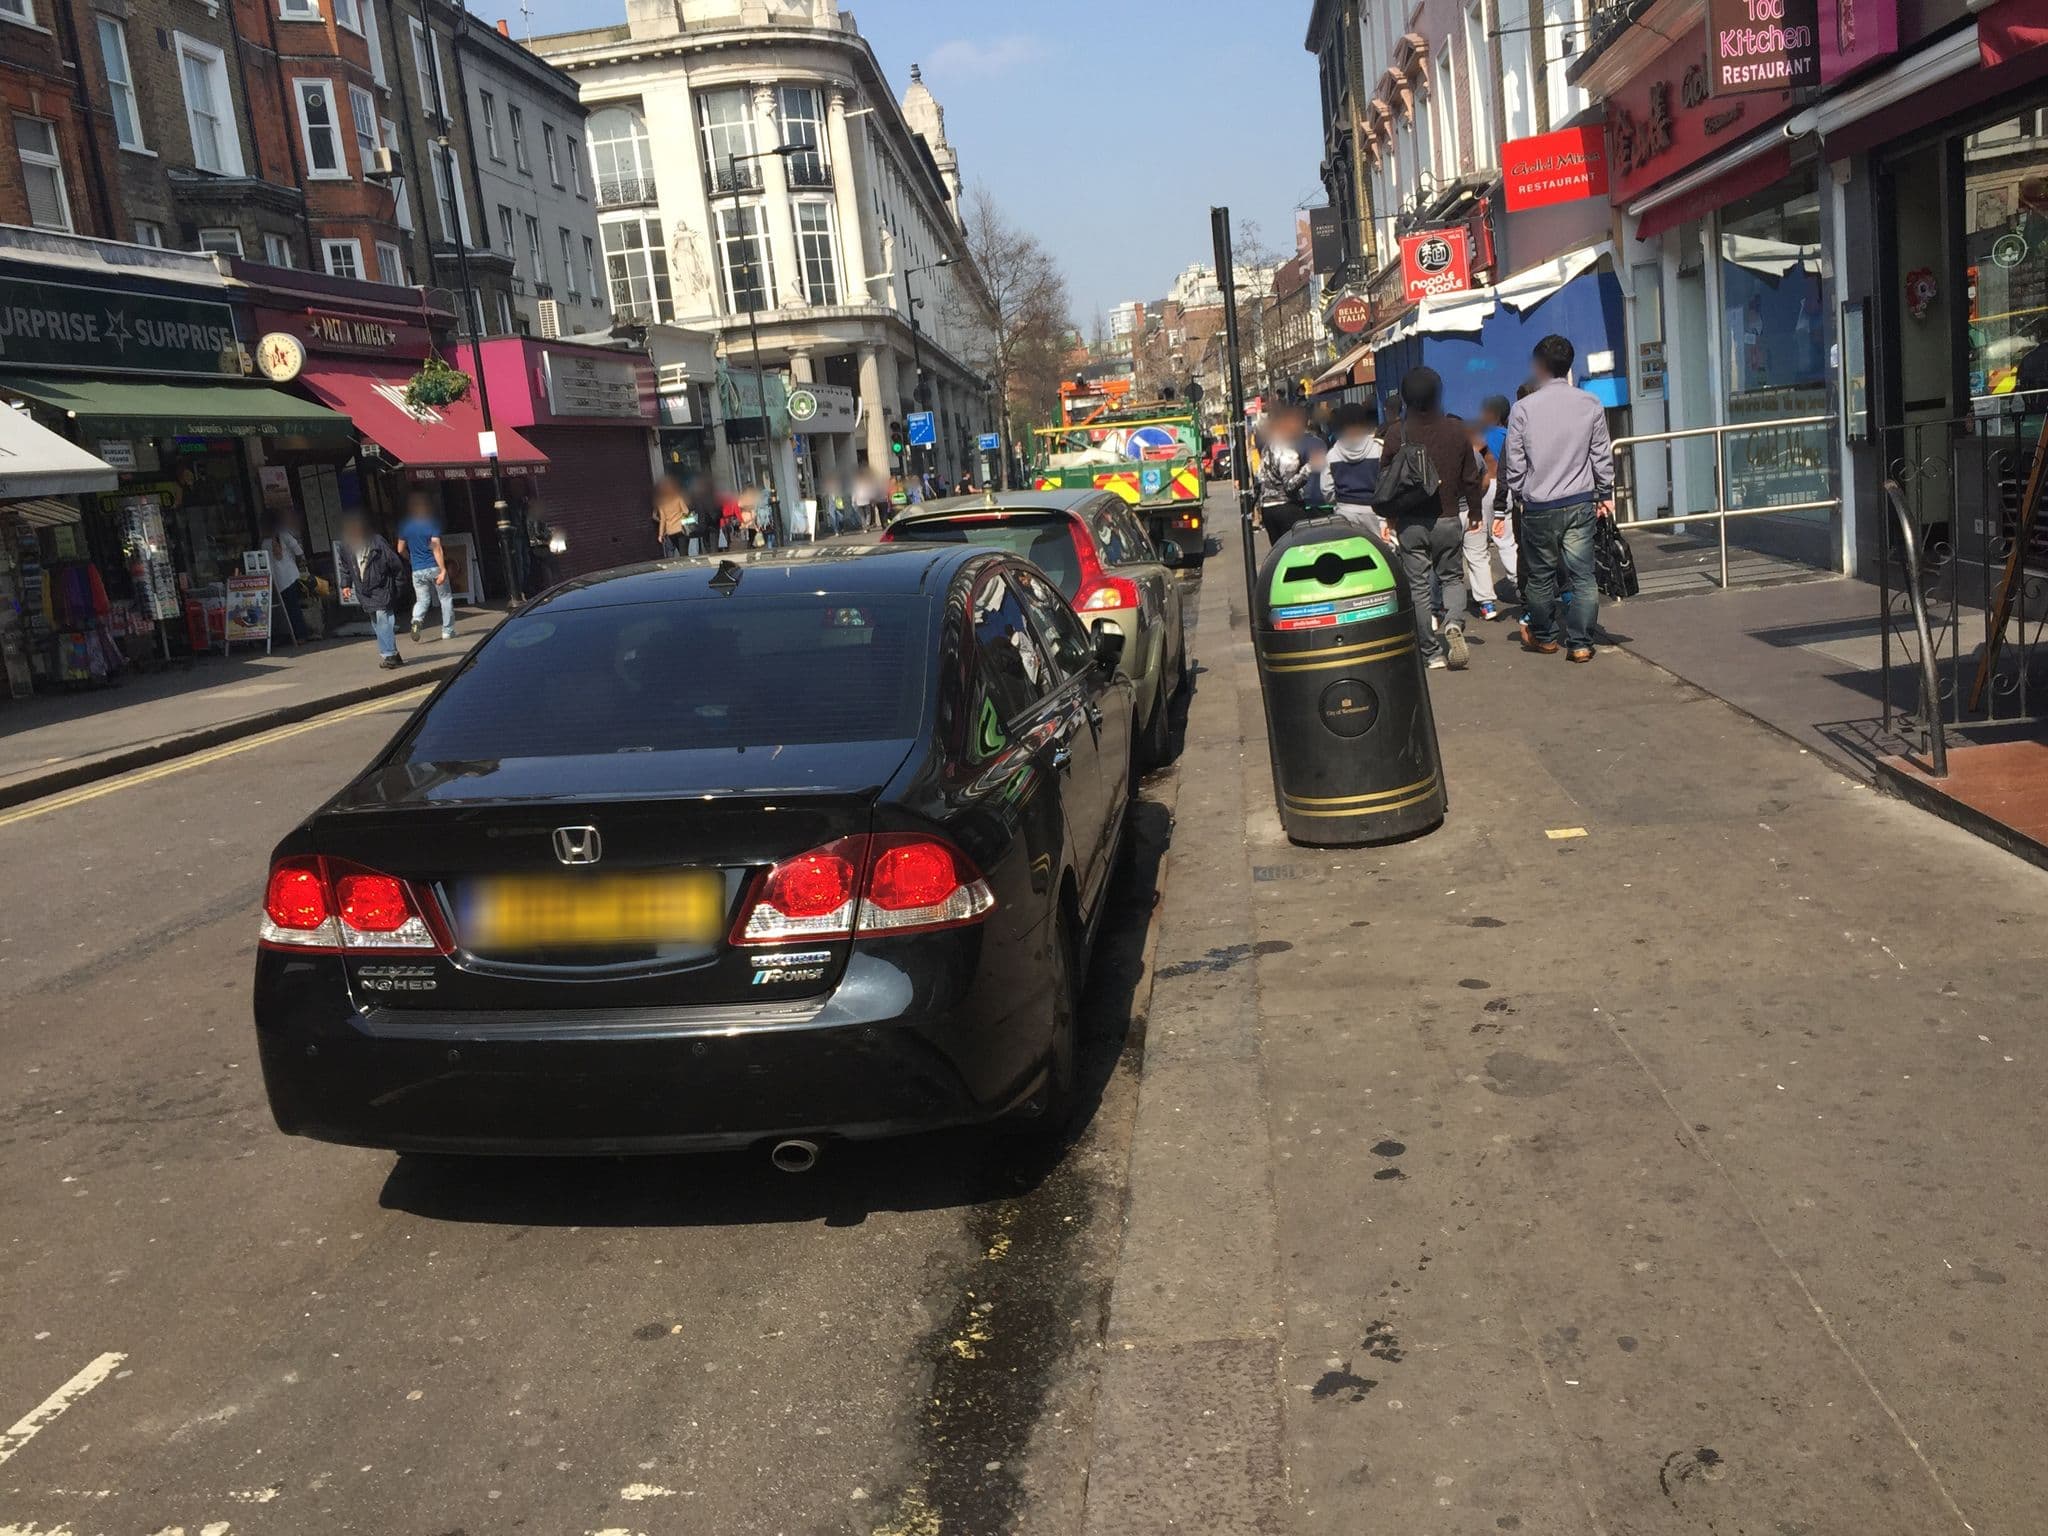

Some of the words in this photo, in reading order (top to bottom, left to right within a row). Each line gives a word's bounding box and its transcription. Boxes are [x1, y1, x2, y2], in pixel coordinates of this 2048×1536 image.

[1720, 24, 1811, 58] Kitchen
[1722, 57, 1812, 85] RESTAURANT
[1511, 157, 1553, 176] Gold
[1556, 151, 1600, 169] Mine
[1518, 172, 1595, 194] RESTAURANT
[1338, 306, 1366, 317] BELLA
[1338, 314, 1367, 324] ITALIA
[135, 318, 233, 352] SURPRISE
[321, 317, 344, 342] PRET
[353, 322, 387, 346] MANGER
[358, 966, 436, 979] CIVIC
[361, 980, 437, 991] N@HED
